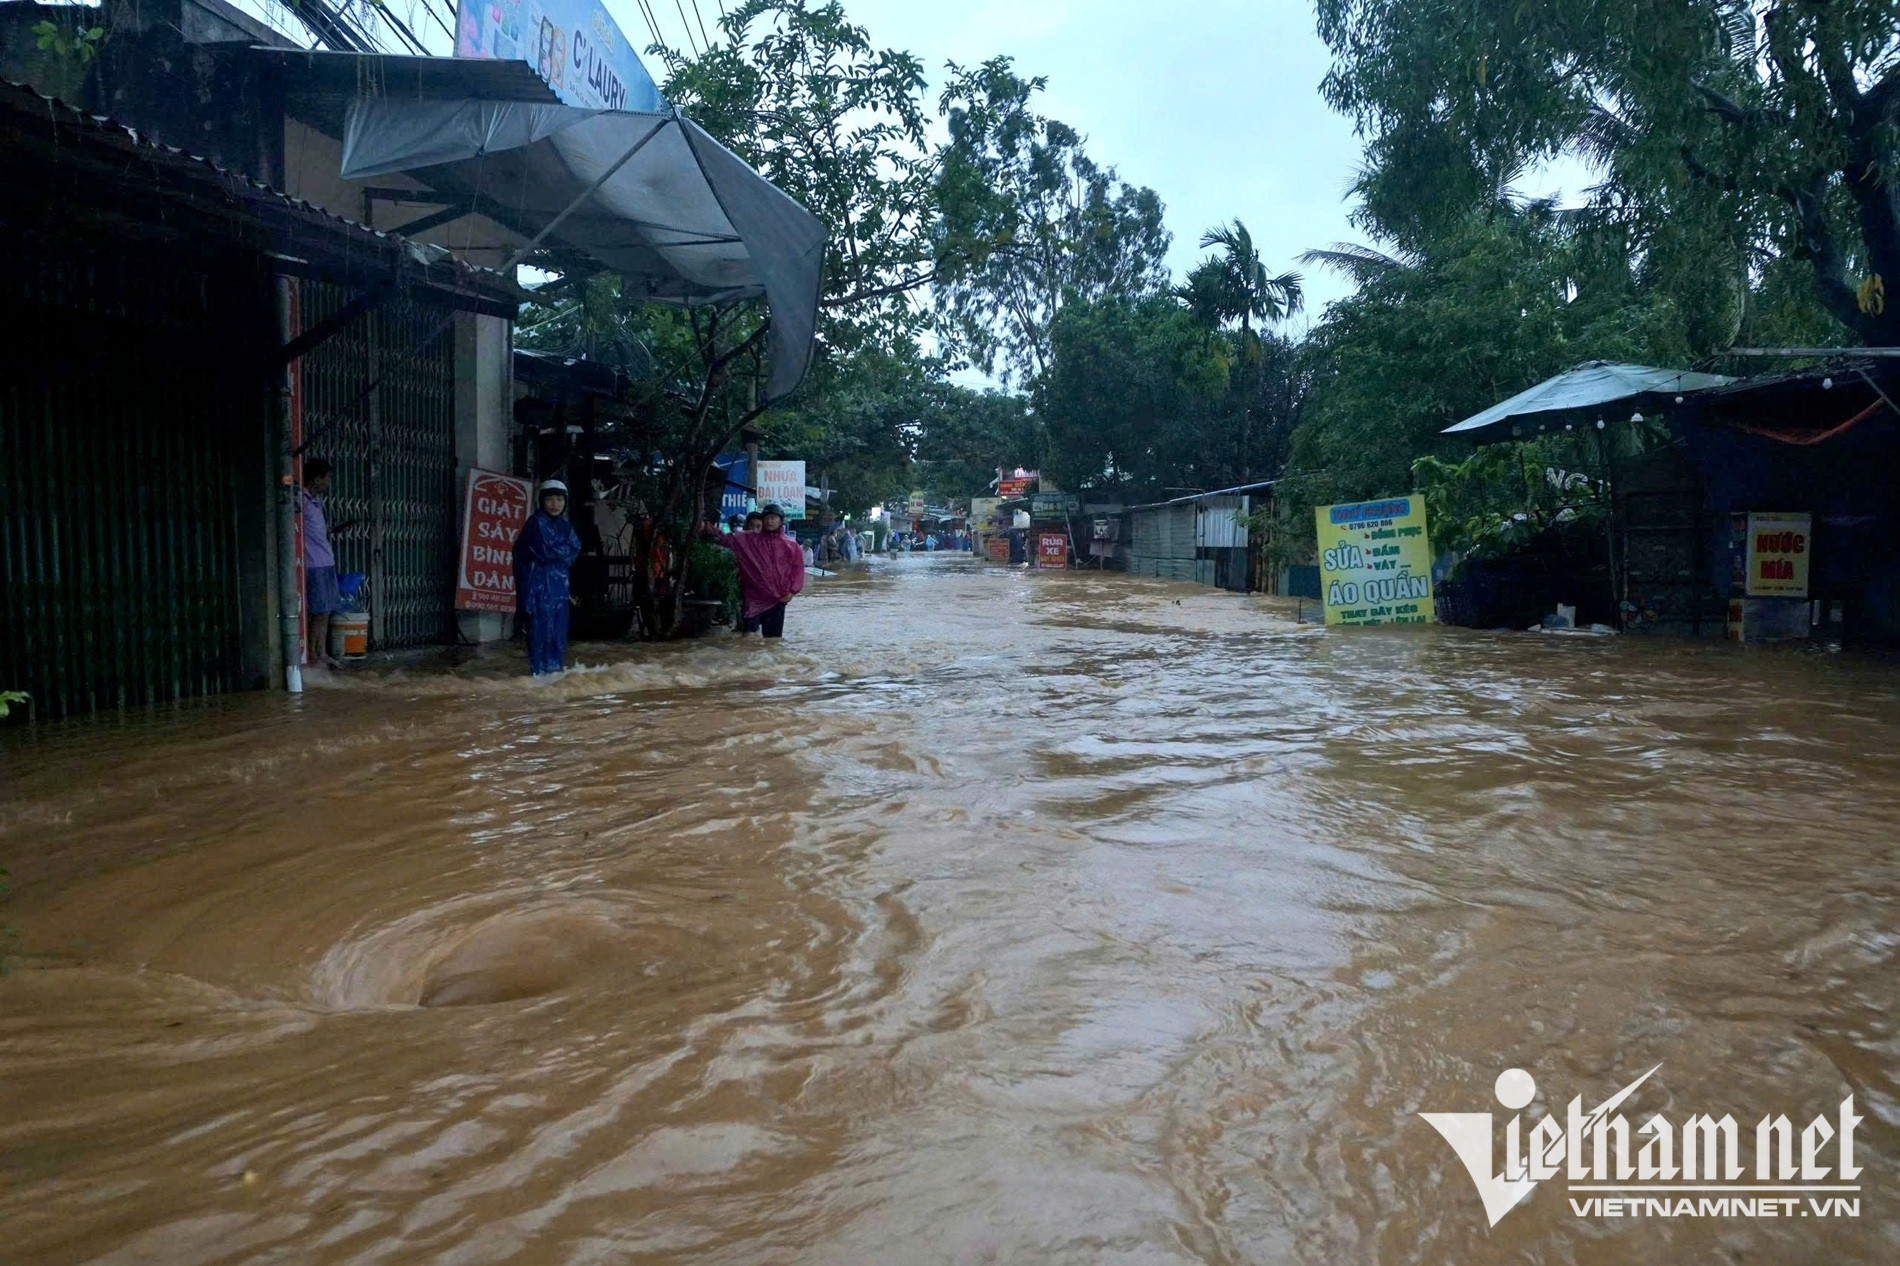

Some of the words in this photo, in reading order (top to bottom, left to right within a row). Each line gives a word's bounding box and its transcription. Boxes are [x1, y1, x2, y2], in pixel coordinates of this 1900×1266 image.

[764, 469, 798, 484] NHỰA
[778, 485, 804, 499] LOAN
[478, 498, 523, 520] GIẶT
[478, 517, 519, 542] SẤY
[1046, 547, 1060, 555] XE
[1757, 531, 1805, 554] NƯỚC
[1324, 540, 1363, 571] SỬA
[1373, 560, 1398, 571] VÁY
[1760, 558, 1794, 580] MÍA
[474, 570, 515, 590] DÂN
[1328, 580, 1359, 606] ÁO
[1364, 570, 1429, 604] QUẦN
[1341, 609, 1368, 619] THAY
[1370, 606, 1393, 616] DÂY
[1396, 604, 1419, 614] KÉO
